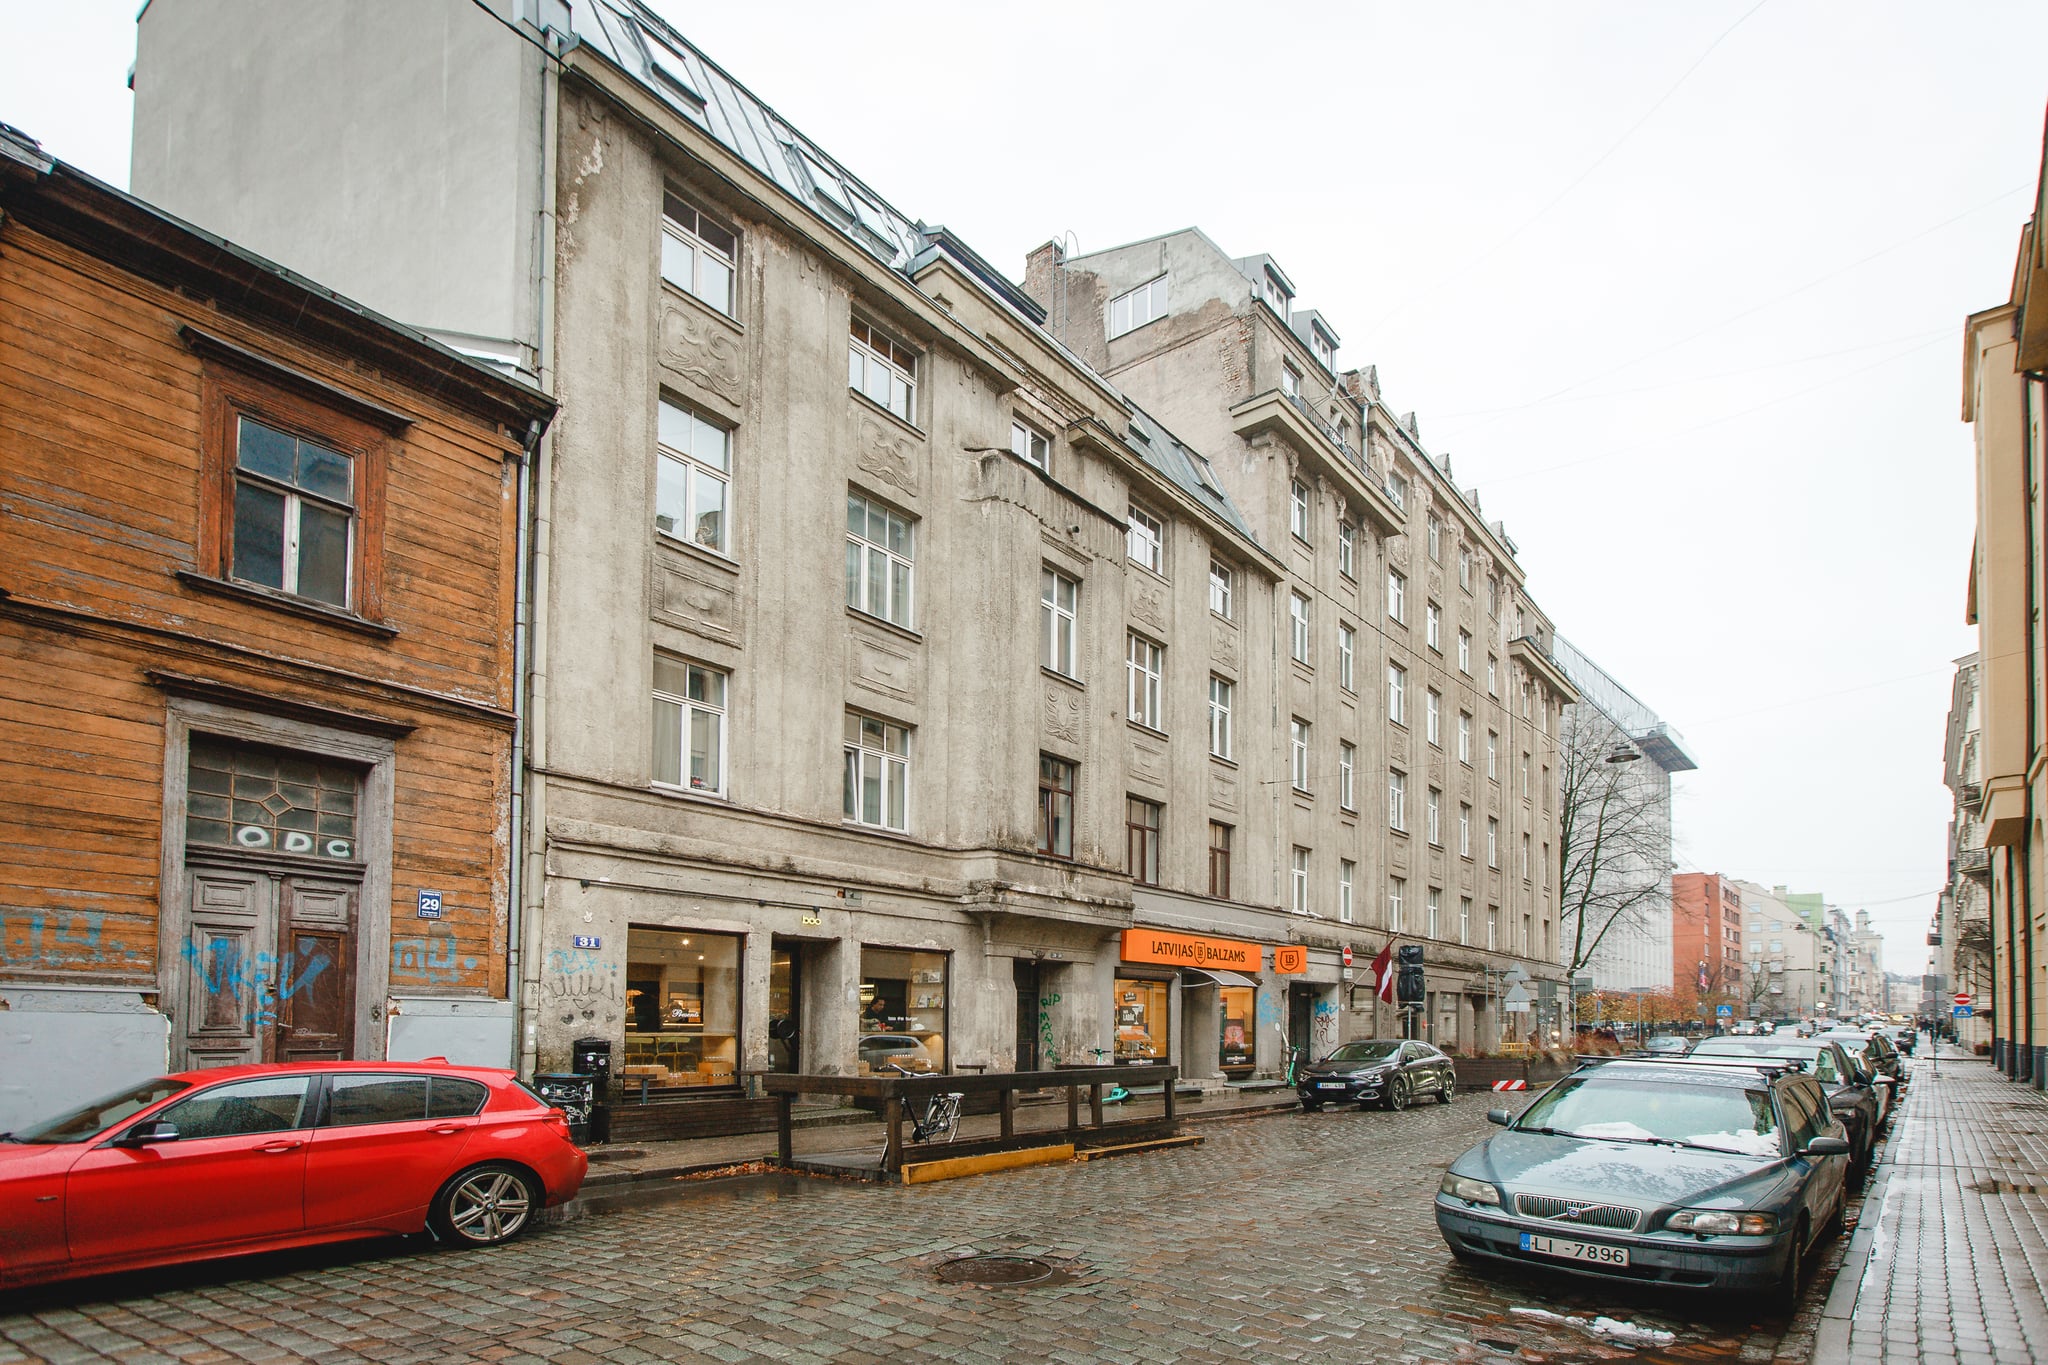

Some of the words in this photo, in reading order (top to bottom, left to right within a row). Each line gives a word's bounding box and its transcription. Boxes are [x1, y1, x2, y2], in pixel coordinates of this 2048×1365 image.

[421, 897, 440, 911] 29
[802, 914, 822, 926] boo
[579, 938, 597, 947] 31
[1152, 940, 1194, 959] LATVIJAS
[1206, 947, 1246, 963] BALZAMS
[1285, 954, 1295, 965] LB
